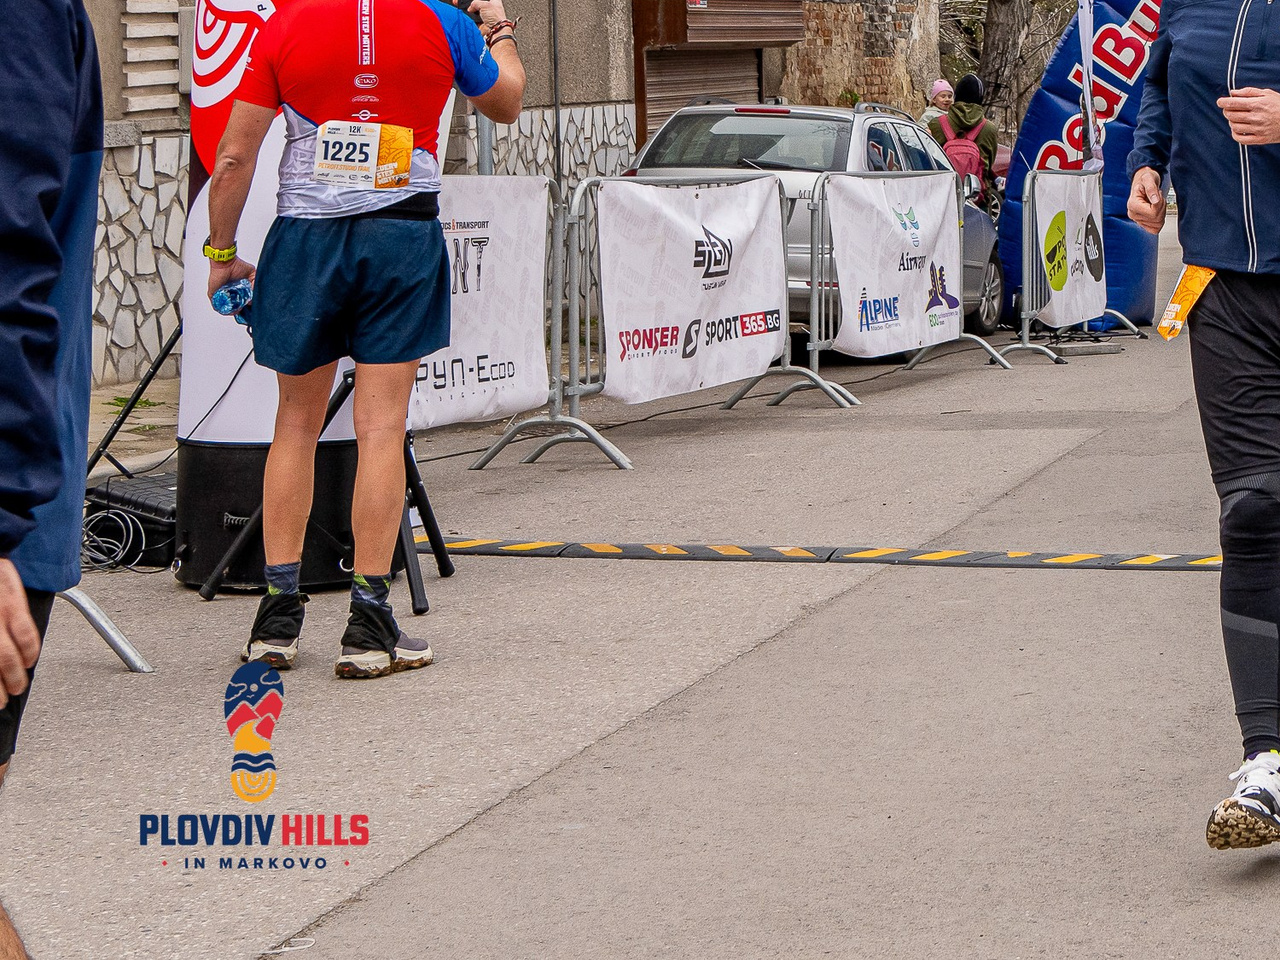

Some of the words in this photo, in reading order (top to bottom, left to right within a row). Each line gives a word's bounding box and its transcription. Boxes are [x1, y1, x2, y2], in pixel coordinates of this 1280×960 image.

[349, 125, 362, 134] 12K
[322, 140, 370, 163] 1225
[859, 296, 900, 332] ALPINE
[618, 326, 680, 362] SPONSER
